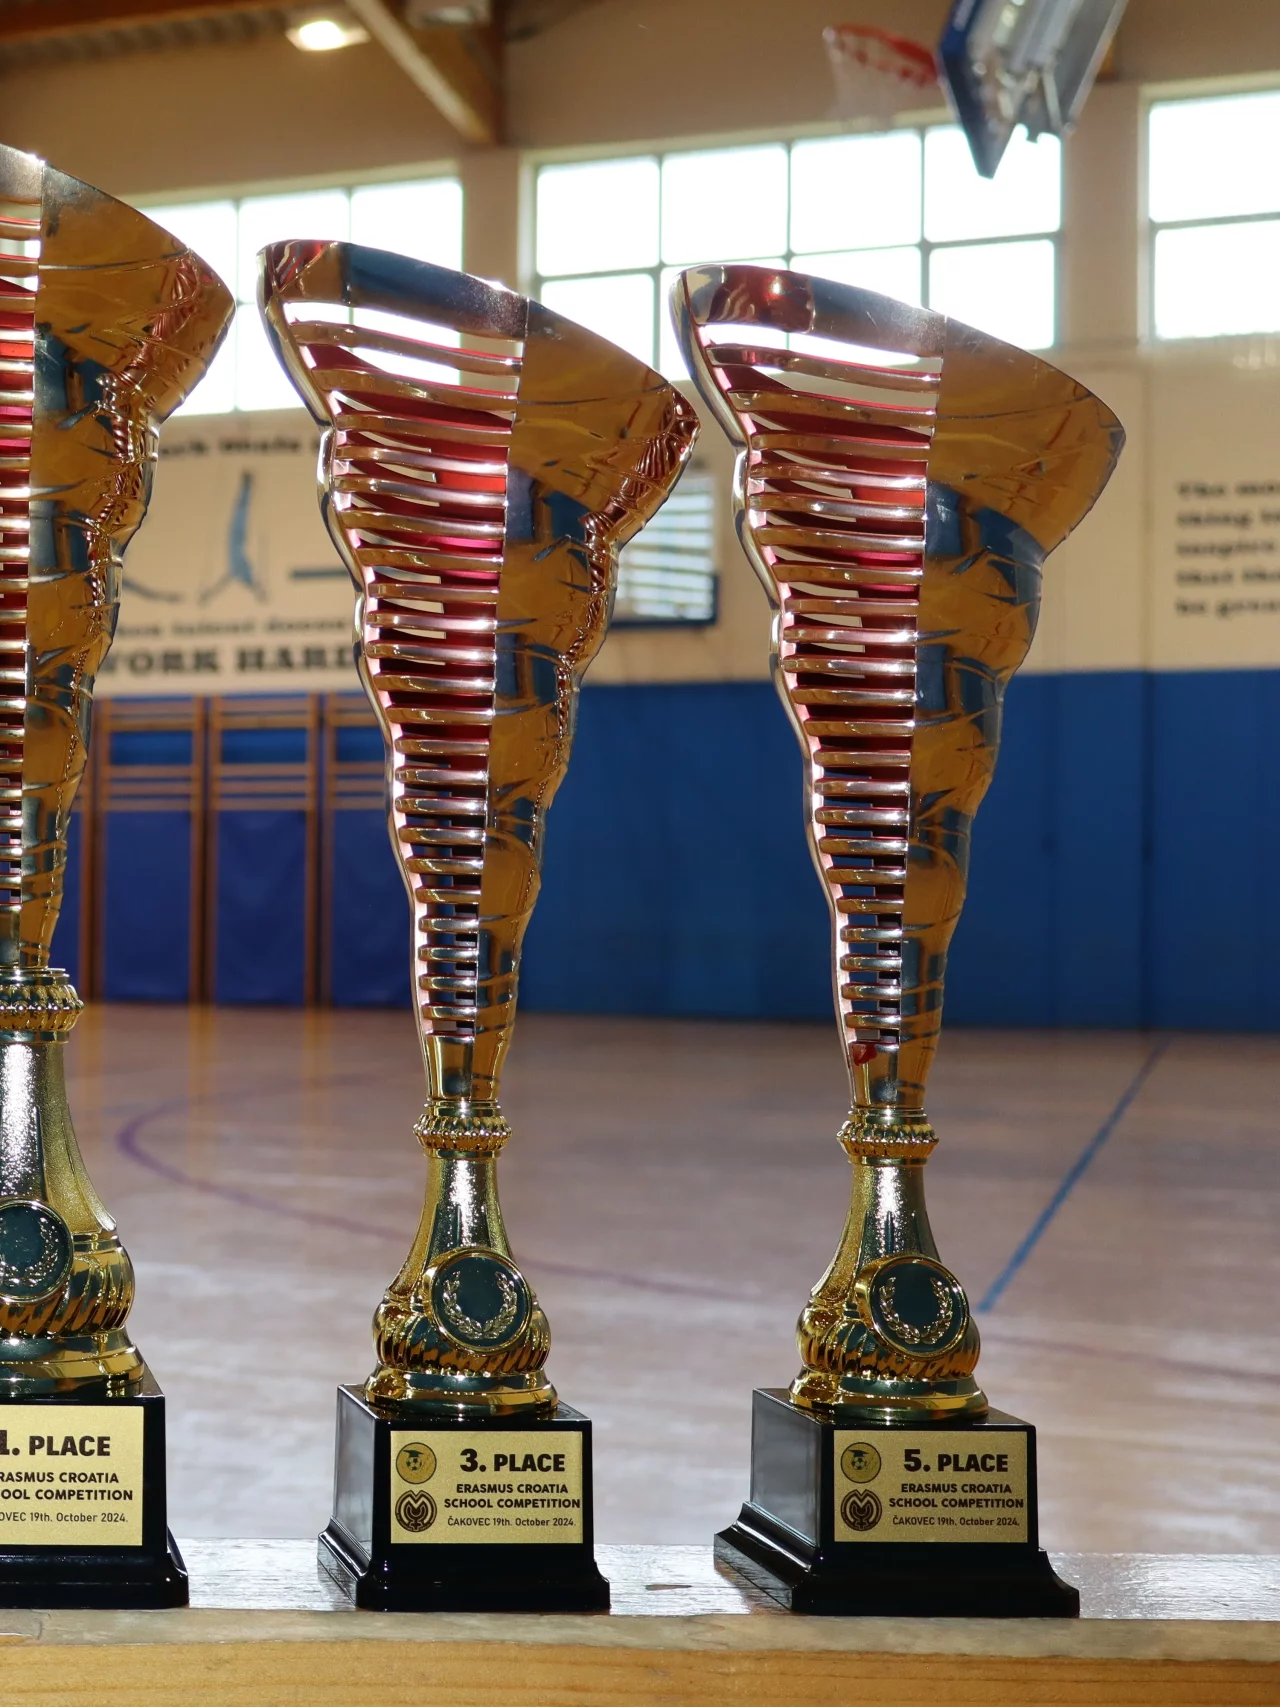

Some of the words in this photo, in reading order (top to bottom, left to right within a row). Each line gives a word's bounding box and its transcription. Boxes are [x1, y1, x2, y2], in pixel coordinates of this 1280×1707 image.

[28, 1435, 111, 1457] PLACE
[460, 1448, 487, 1472] 3.
[494, 1453, 565, 1472] PLACE
[904, 1449, 931, 1472] 5.
[937, 1454, 1008, 1472] PLACE
[59, 1472, 119, 1483] CROATIA
[456, 1483, 514, 1493] ERASMUS
[517, 1483, 568, 1494] CROATIA
[901, 1483, 958, 1493] ERASMUS
[961, 1483, 1012, 1493] CROATIA
[35, 1488, 133, 1501] COMPETITION
[444, 1498, 494, 1508] SCHOOL
[497, 1498, 580, 1508] COMPETITION
[889, 1498, 938, 1508] SCHOOL
[941, 1498, 1024, 1508] COMPETITION
[30, 1512, 53, 1522] 19th.
[56, 1512, 98, 1523] October
[101, 1512, 129, 1523] 2024.
[448, 1515, 490, 1526] ČAKOVEC
[493, 1517, 513, 1526] 19th.
[515, 1517, 550, 1526] October
[553, 1517, 576, 1526] 2024.
[893, 1514, 935, 1525] ČAKOVEC
[937, 1517, 957, 1526] 19th.
[959, 1517, 994, 1526] October
[997, 1517, 1020, 1526] 2024.
